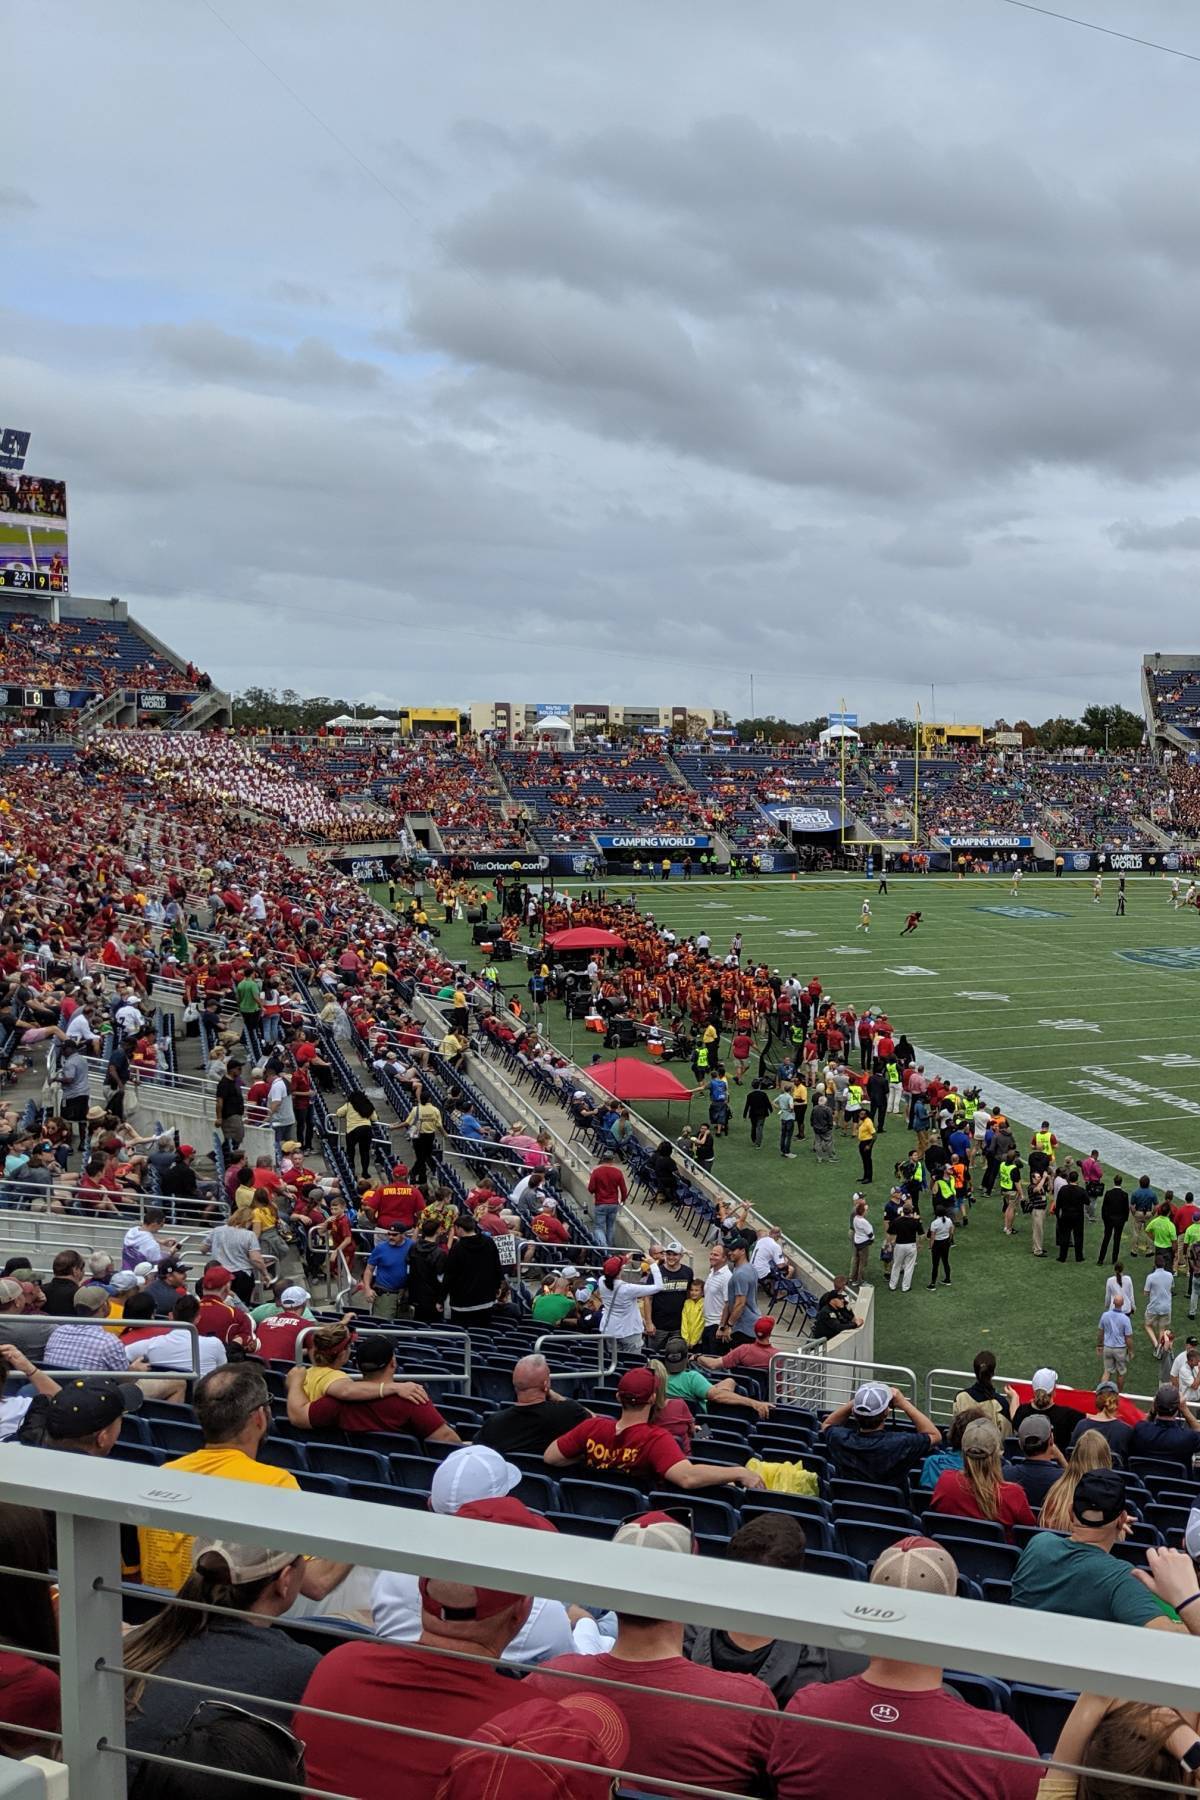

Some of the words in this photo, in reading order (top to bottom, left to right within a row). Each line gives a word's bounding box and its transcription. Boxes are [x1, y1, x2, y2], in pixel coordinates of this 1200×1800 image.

[14, 571, 31, 582] 2:21
[39, 576, 46, 587] 9
[142, 700, 167, 709] WORLD
[612, 837, 659, 848] CAMPING
[660, 837, 696, 848] WORLD
[950, 837, 988, 847] CAMPING
[989, 837, 1020, 847] WORLD
[1110, 860, 1143, 869] WORLD
[1080, 1065, 1153, 1093] CAMPING
[1067, 1078, 1150, 1108] STADIUM
[383, 1187, 397, 1196] IOWA
[397, 1187, 412, 1196] STATE
[853, 1605, 895, 1620] W10
